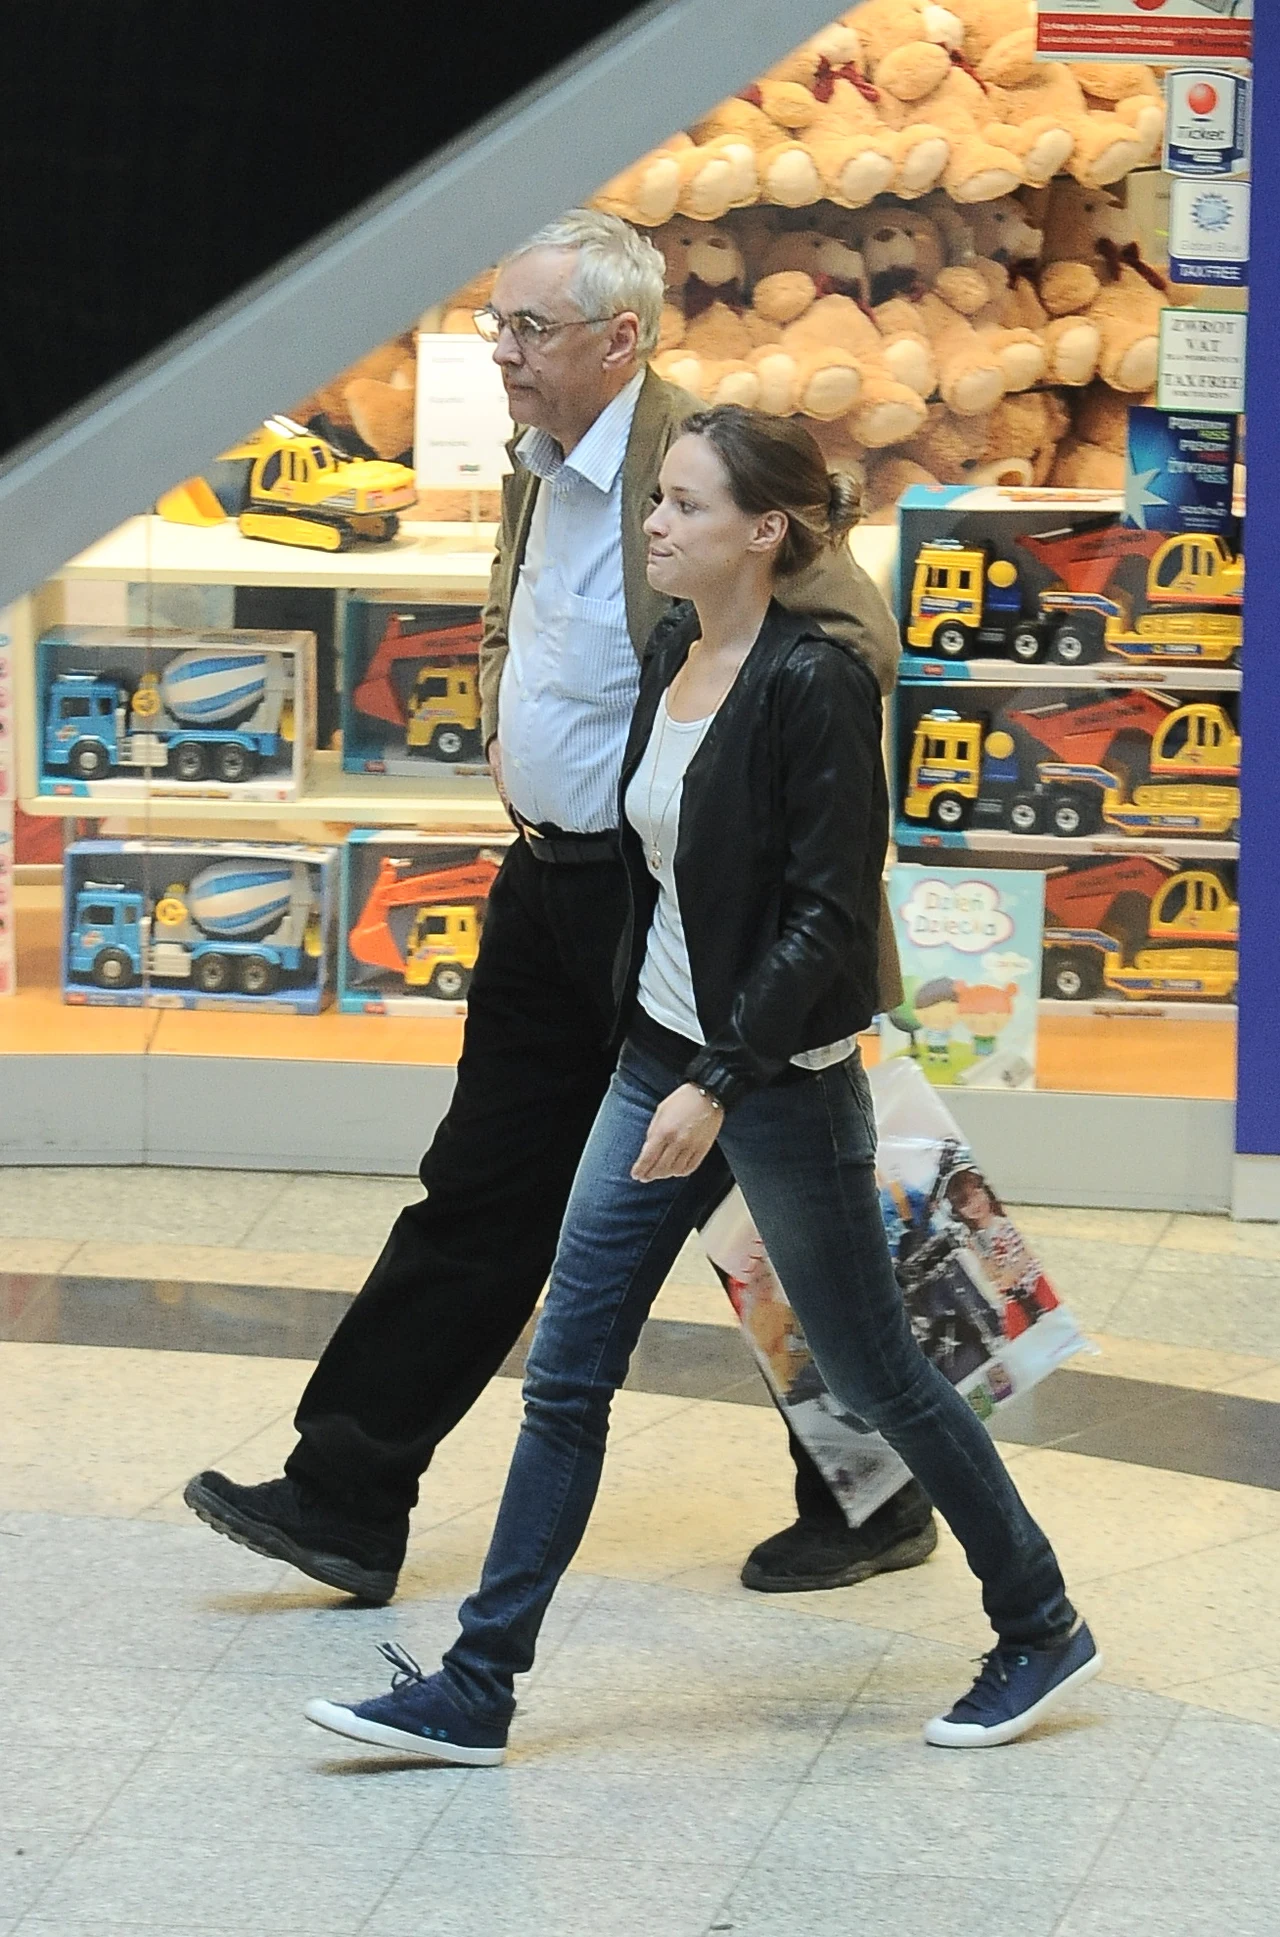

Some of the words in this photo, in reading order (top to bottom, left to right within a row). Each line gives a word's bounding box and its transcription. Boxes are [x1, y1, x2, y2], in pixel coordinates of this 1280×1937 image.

[1171, 319, 1236, 334] ZWROT
[1185, 338, 1221, 352] VAT
[1161, 372, 1197, 387] TAX
[1199, 374, 1243, 389] FREE
